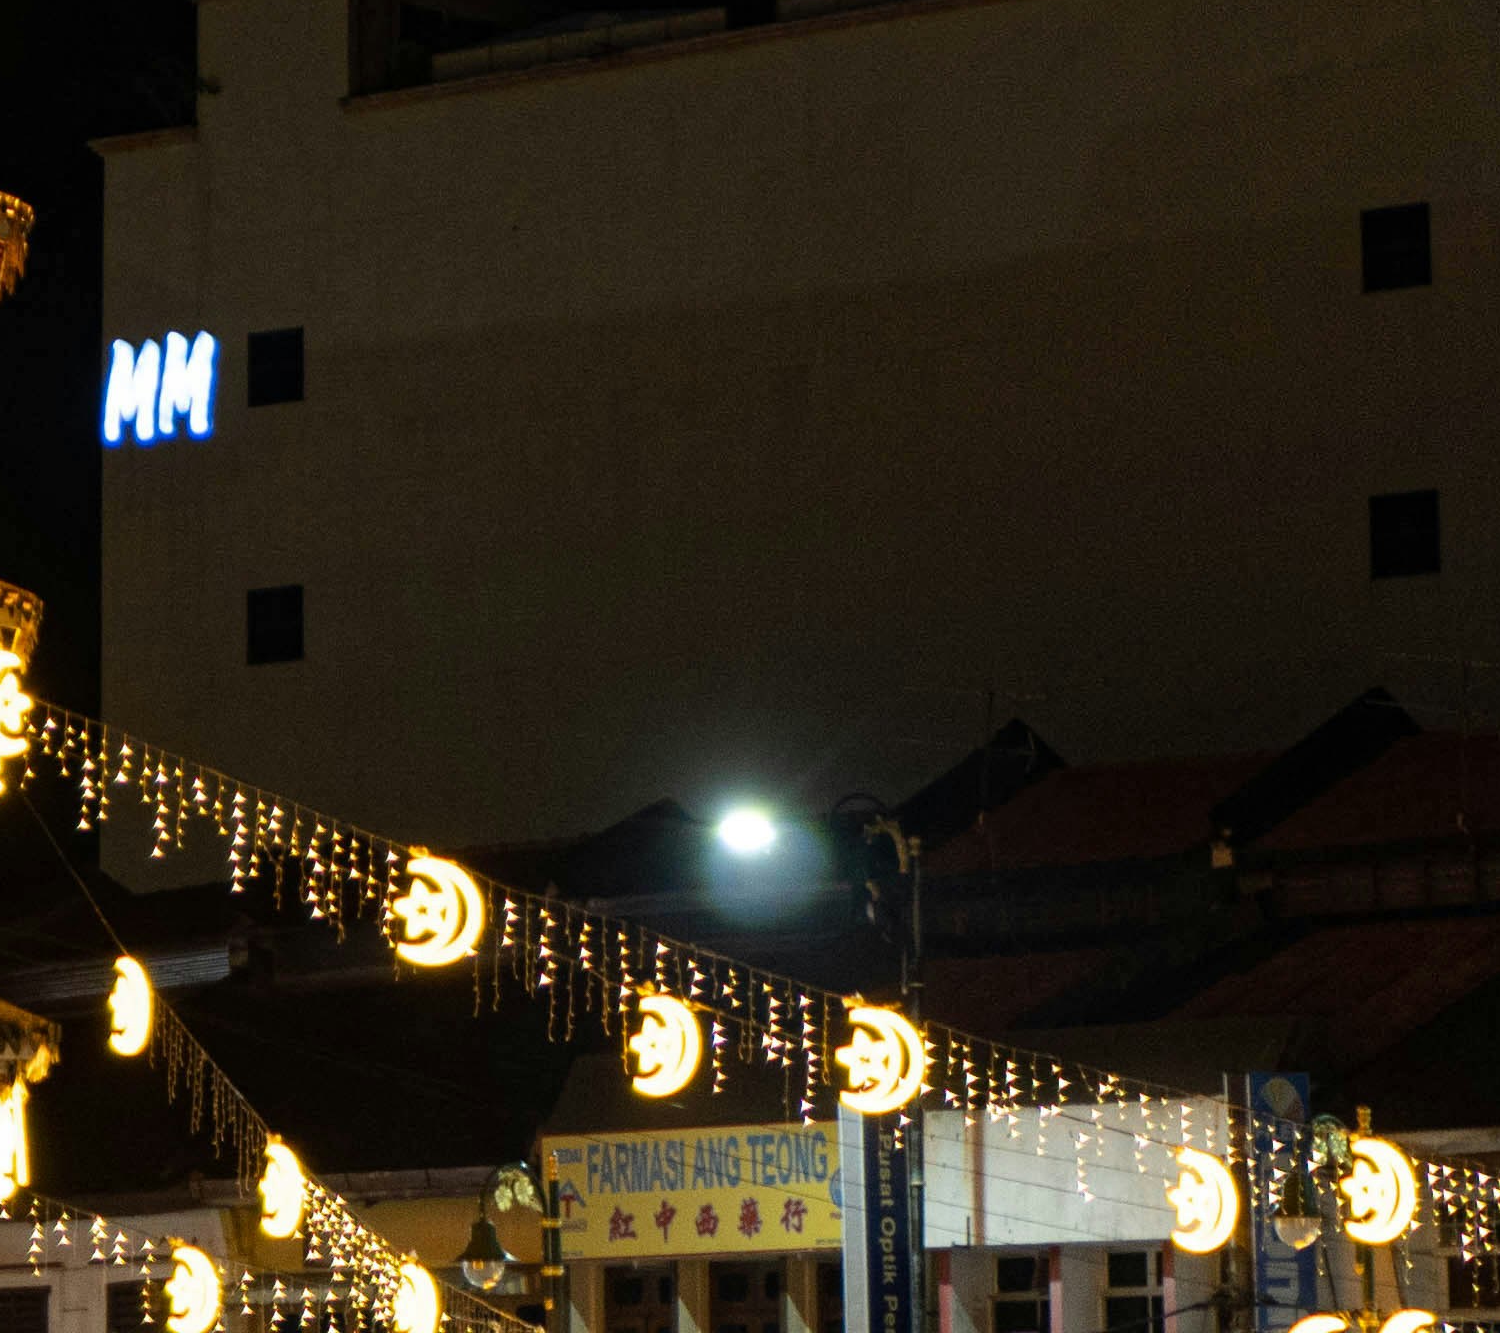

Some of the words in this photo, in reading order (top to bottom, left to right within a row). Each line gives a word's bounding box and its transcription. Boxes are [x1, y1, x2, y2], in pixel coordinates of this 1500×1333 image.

[102, 329, 217, 445] MM
[586, 1138, 687, 1194] FARMASI
[693, 1134, 742, 1189] ANG
[747, 1130, 829, 1186] TEONG
[878, 1132, 895, 1208] Pusat
[878, 1216, 898, 1285] Optik
